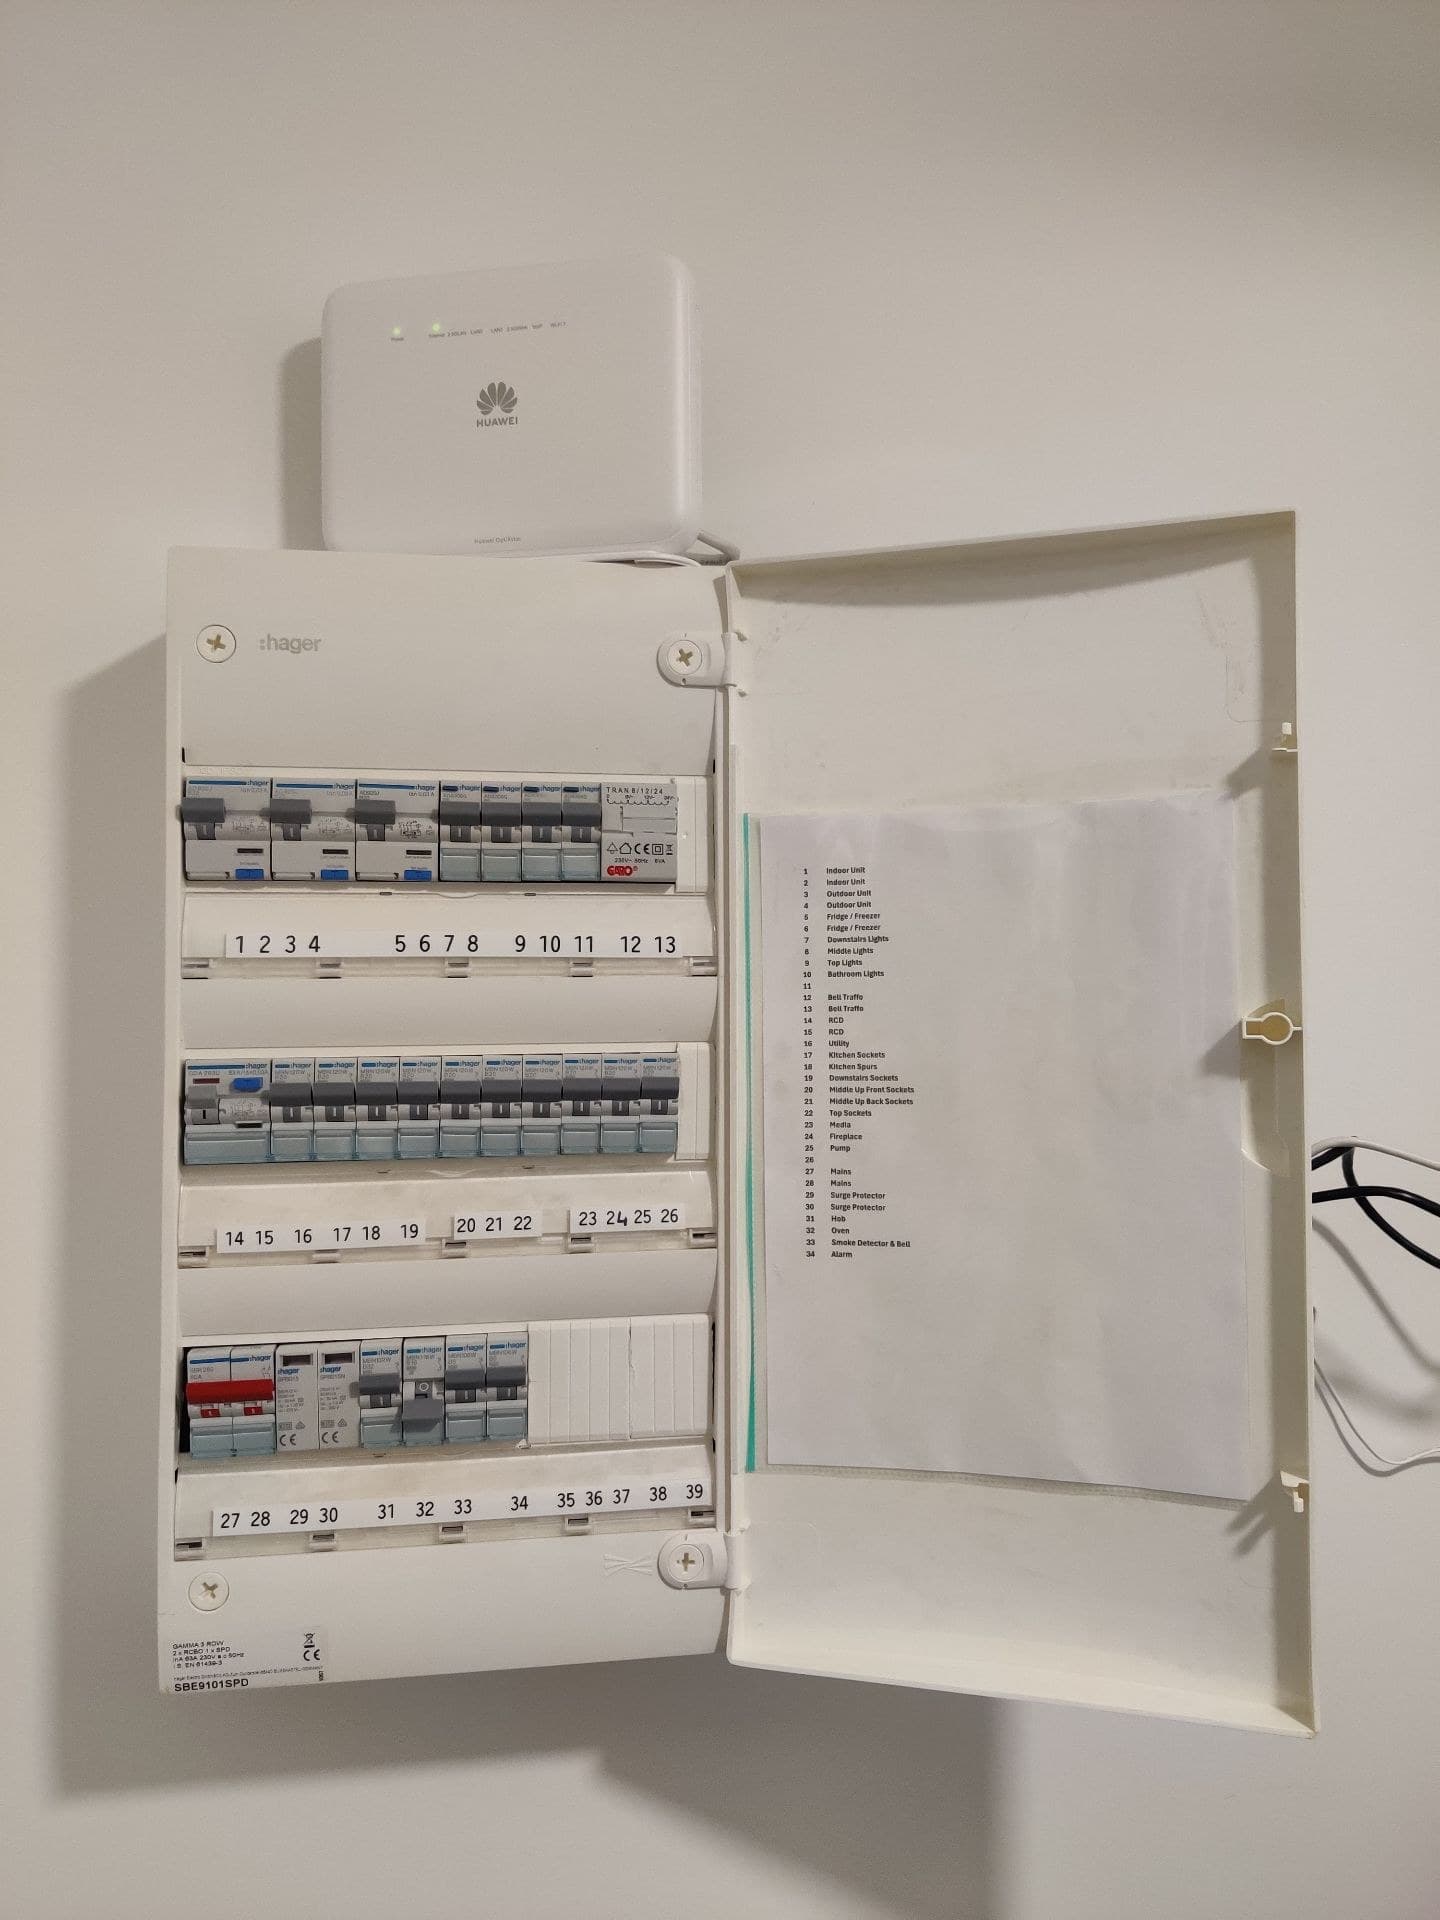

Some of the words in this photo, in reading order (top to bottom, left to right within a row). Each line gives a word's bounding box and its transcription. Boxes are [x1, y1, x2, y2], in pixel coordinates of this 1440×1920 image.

[476, 416, 518, 428] HUAWEI
[606, 786, 629, 794] TRAN
[632, 787, 663, 795] 8/12/24
[827, 925, 848, 933] Fridge
[827, 935, 866, 943] Downstairs
[868, 935, 889, 943] Lights
[236, 935, 243, 953] 1
[260, 936, 270, 953] 2
[285, 935, 295, 953] 3
[309, 936, 320, 952] 4
[396, 935, 406, 952] 5
[420, 935, 430, 952] 6
[444, 935, 454, 952] 7
[468, 935, 478, 952] 8
[515, 935, 525, 952] 9
[540, 935, 561, 952] 10
[574, 935, 593, 952] 11
[621, 936, 641, 952] 12
[655, 936, 676, 953] 13
[828, 948, 851, 956] Middle
[842, 959, 862, 967] Lights
[864, 970, 884, 978] Lights
[828, 1040, 849, 1048] Utility
[857, 1063, 877, 1071] Spurs
[886, 1086, 914, 1094] Sockets
[855, 1098, 865, 1106] Up
[829, 1110, 842, 1118] Top
[844, 1109, 872, 1118] Sockets
[804, 1133, 813, 1141] 24
[830, 1133, 862, 1141] Fireplace
[830, 1145, 850, 1153] Pump
[804, 1168, 814, 1176] 27
[831, 1192, 851, 1200] Surge
[831, 1203, 851, 1212] Surge
[852, 1203, 886, 1212] Protector
[579, 1211, 597, 1226] 23
[607, 1211, 627, 1226] 24
[634, 1210, 652, 1225] 25
[661, 1208, 679, 1223] 26
[805, 1215, 814, 1223] 31
[457, 1218, 476, 1233] 20
[486, 1217, 502, 1231] 21
[514, 1216, 532, 1230] 22
[226, 1231, 244, 1246] 14
[256, 1230, 274, 1245] 15
[295, 1229, 312, 1243] 16
[333, 1227, 351, 1242] 17
[363, 1226, 380, 1240] 18
[401, 1224, 419, 1238] 19
[805, 1227, 815, 1235] 32
[221, 1513, 240, 1528] 27
[251, 1511, 270, 1526] 28
[290, 1509, 308, 1524] 29
[319, 1508, 338, 1523] 30
[378, 1504, 395, 1519] 31
[416, 1502, 434, 1517] 32
[454, 1499, 472, 1514] 33
[511, 1496, 528, 1511] 34
[557, 1493, 575, 1508] 35
[586, 1490, 602, 1506] 36
[613, 1489, 630, 1504] 37
[650, 1486, 667, 1501] 38
[686, 1484, 703, 1499] 39
[174, 1678, 249, 1692] SBE9101SPD
